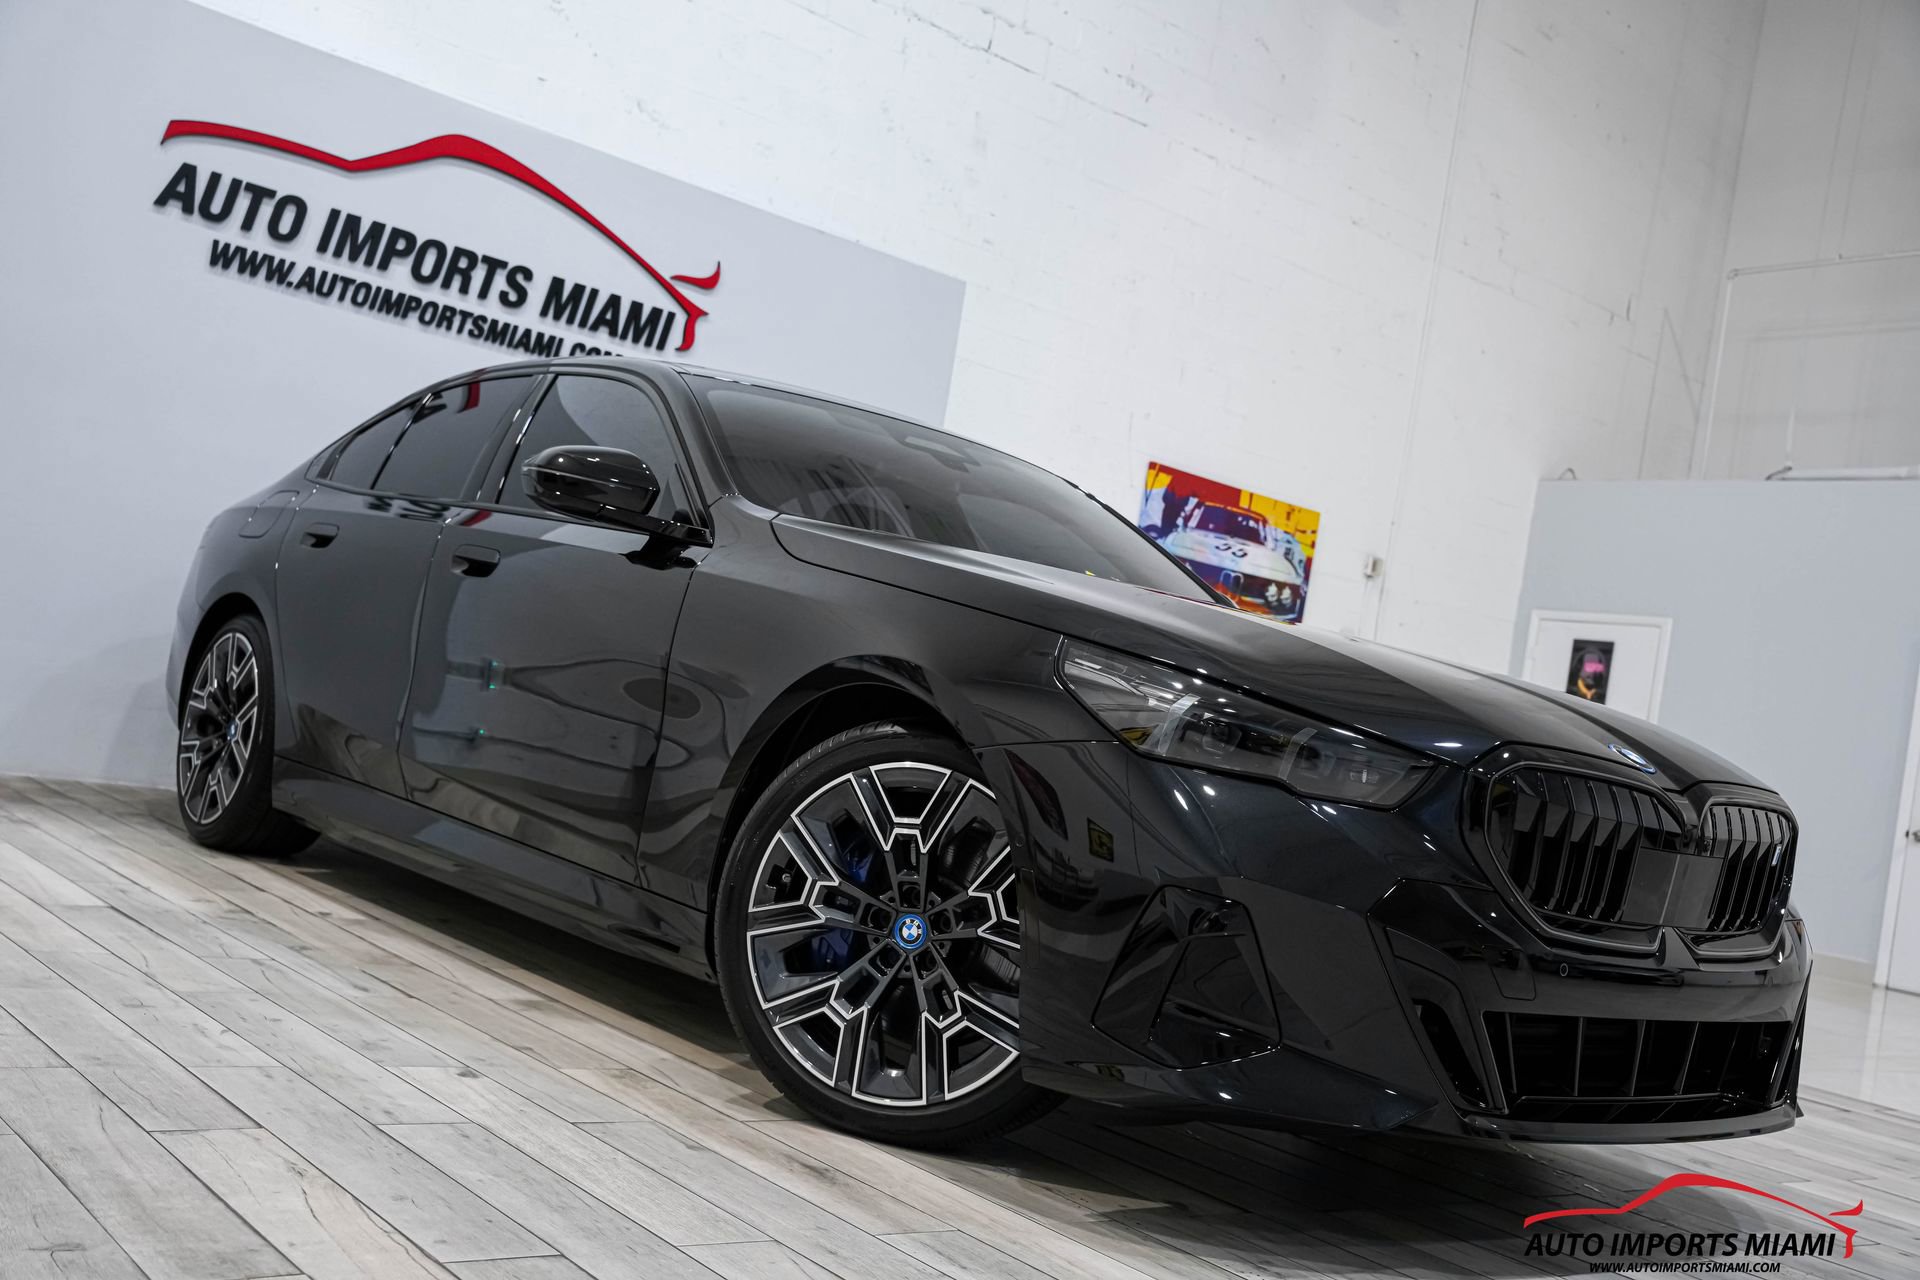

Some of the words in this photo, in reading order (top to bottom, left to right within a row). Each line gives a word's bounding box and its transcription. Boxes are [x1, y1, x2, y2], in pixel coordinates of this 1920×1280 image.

[153, 162, 308, 243] AUTO
[316, 208, 533, 309] IMPORTS
[539, 276, 677, 351] MIAMI
